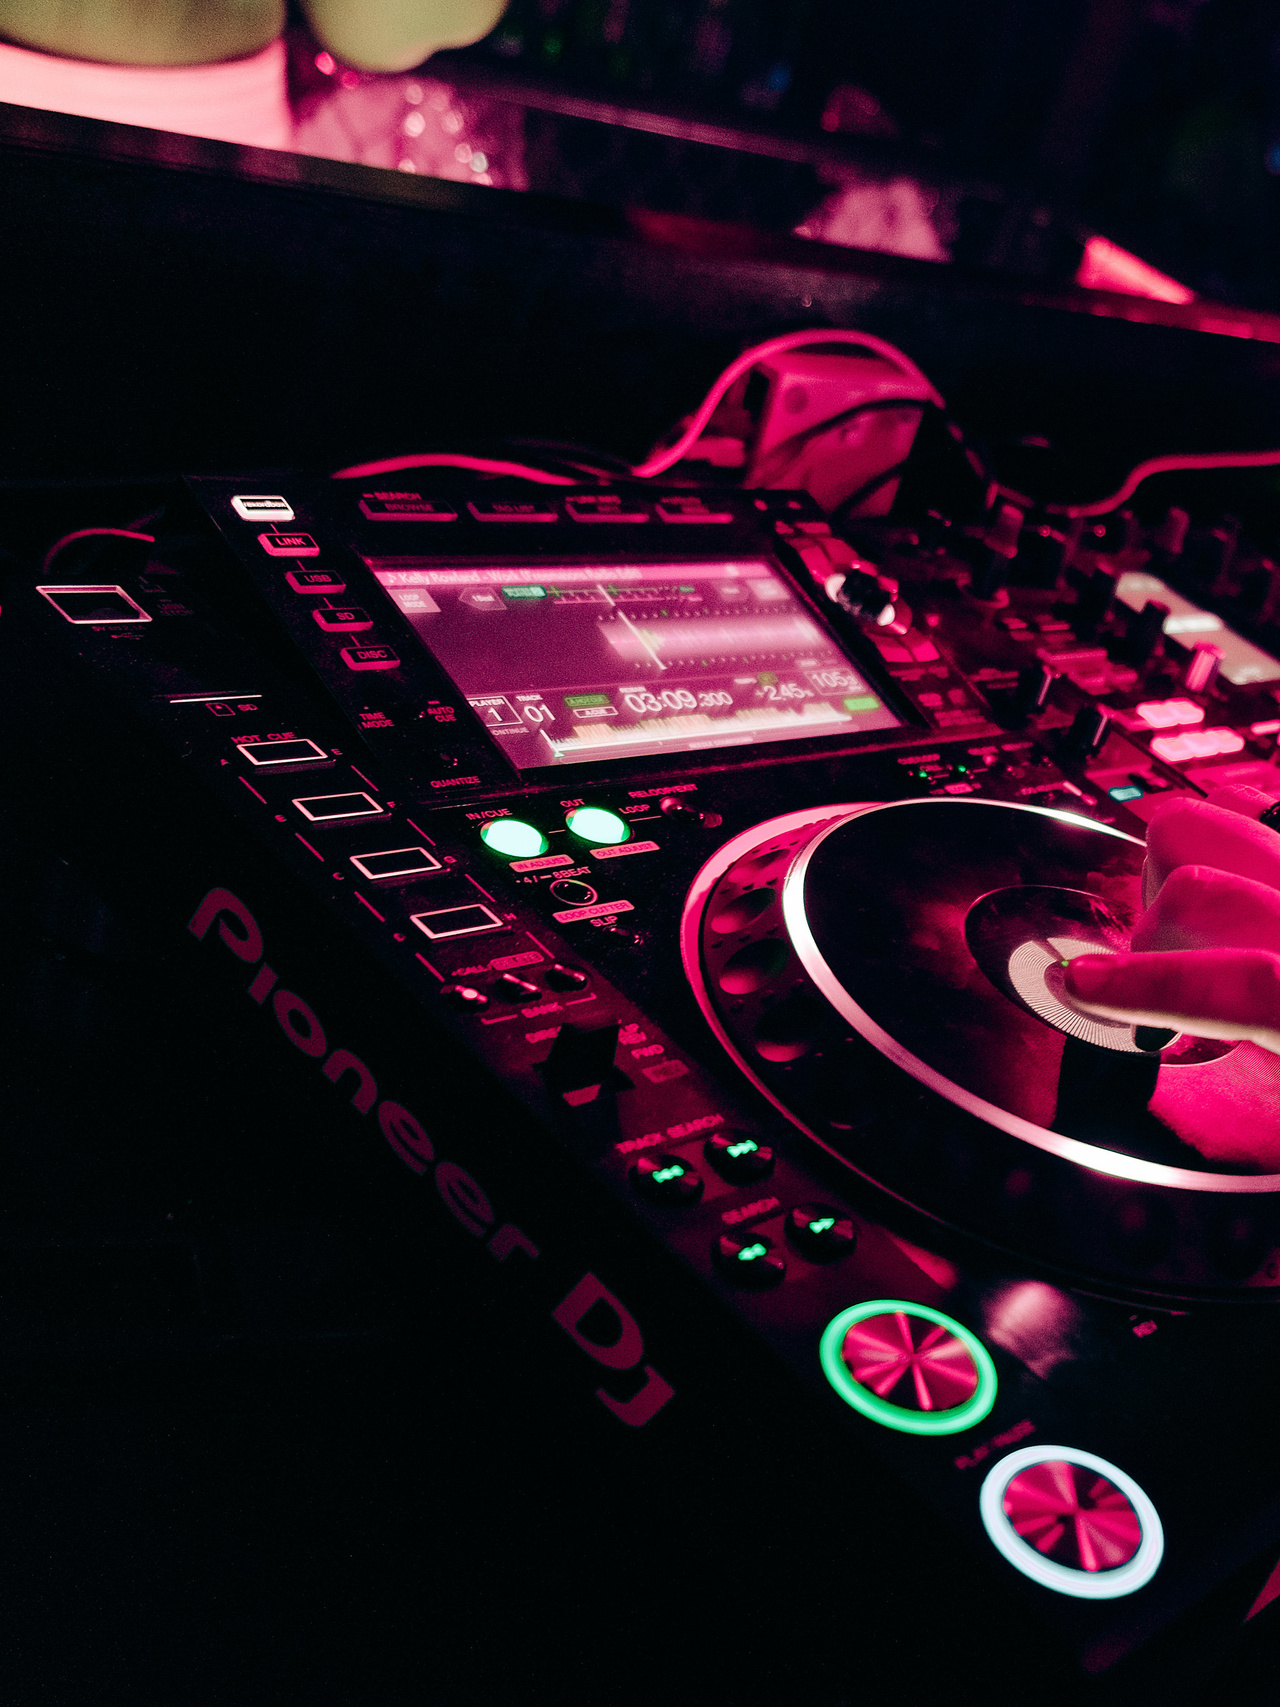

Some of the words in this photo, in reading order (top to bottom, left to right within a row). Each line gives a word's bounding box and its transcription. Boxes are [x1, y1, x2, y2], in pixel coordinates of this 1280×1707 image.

[275, 537, 306, 546] LINK
[304, 574, 332, 583] USB
[398, 572, 431, 585] Kelly
[429, 571, 481, 582] Rowland
[336, 612, 355, 620] SD
[356, 650, 388, 660] DISC
[468, 698, 505, 708] PLAYER
[426, 705, 455, 715] AUTO
[488, 706, 503, 722] 1
[523, 704, 556, 723] 01
[358, 711, 387, 721] TIME
[434, 713, 458, 723] CUE
[360, 719, 396, 729] MODE
[230, 734, 262, 746] HOT
[266, 731, 299, 742] CUE
[429, 775, 482, 788] QUANTIZE
[559, 798, 586, 808] OUT
[465, 808, 514, 820] IN/CUE
[618, 804, 651, 814] LOOP
[558, 910, 587, 921] LOOP
[588, 902, 630, 915] CUTTER
[589, 915, 618, 927] SLIP
[187, 886, 541, 1263] Pioneer
